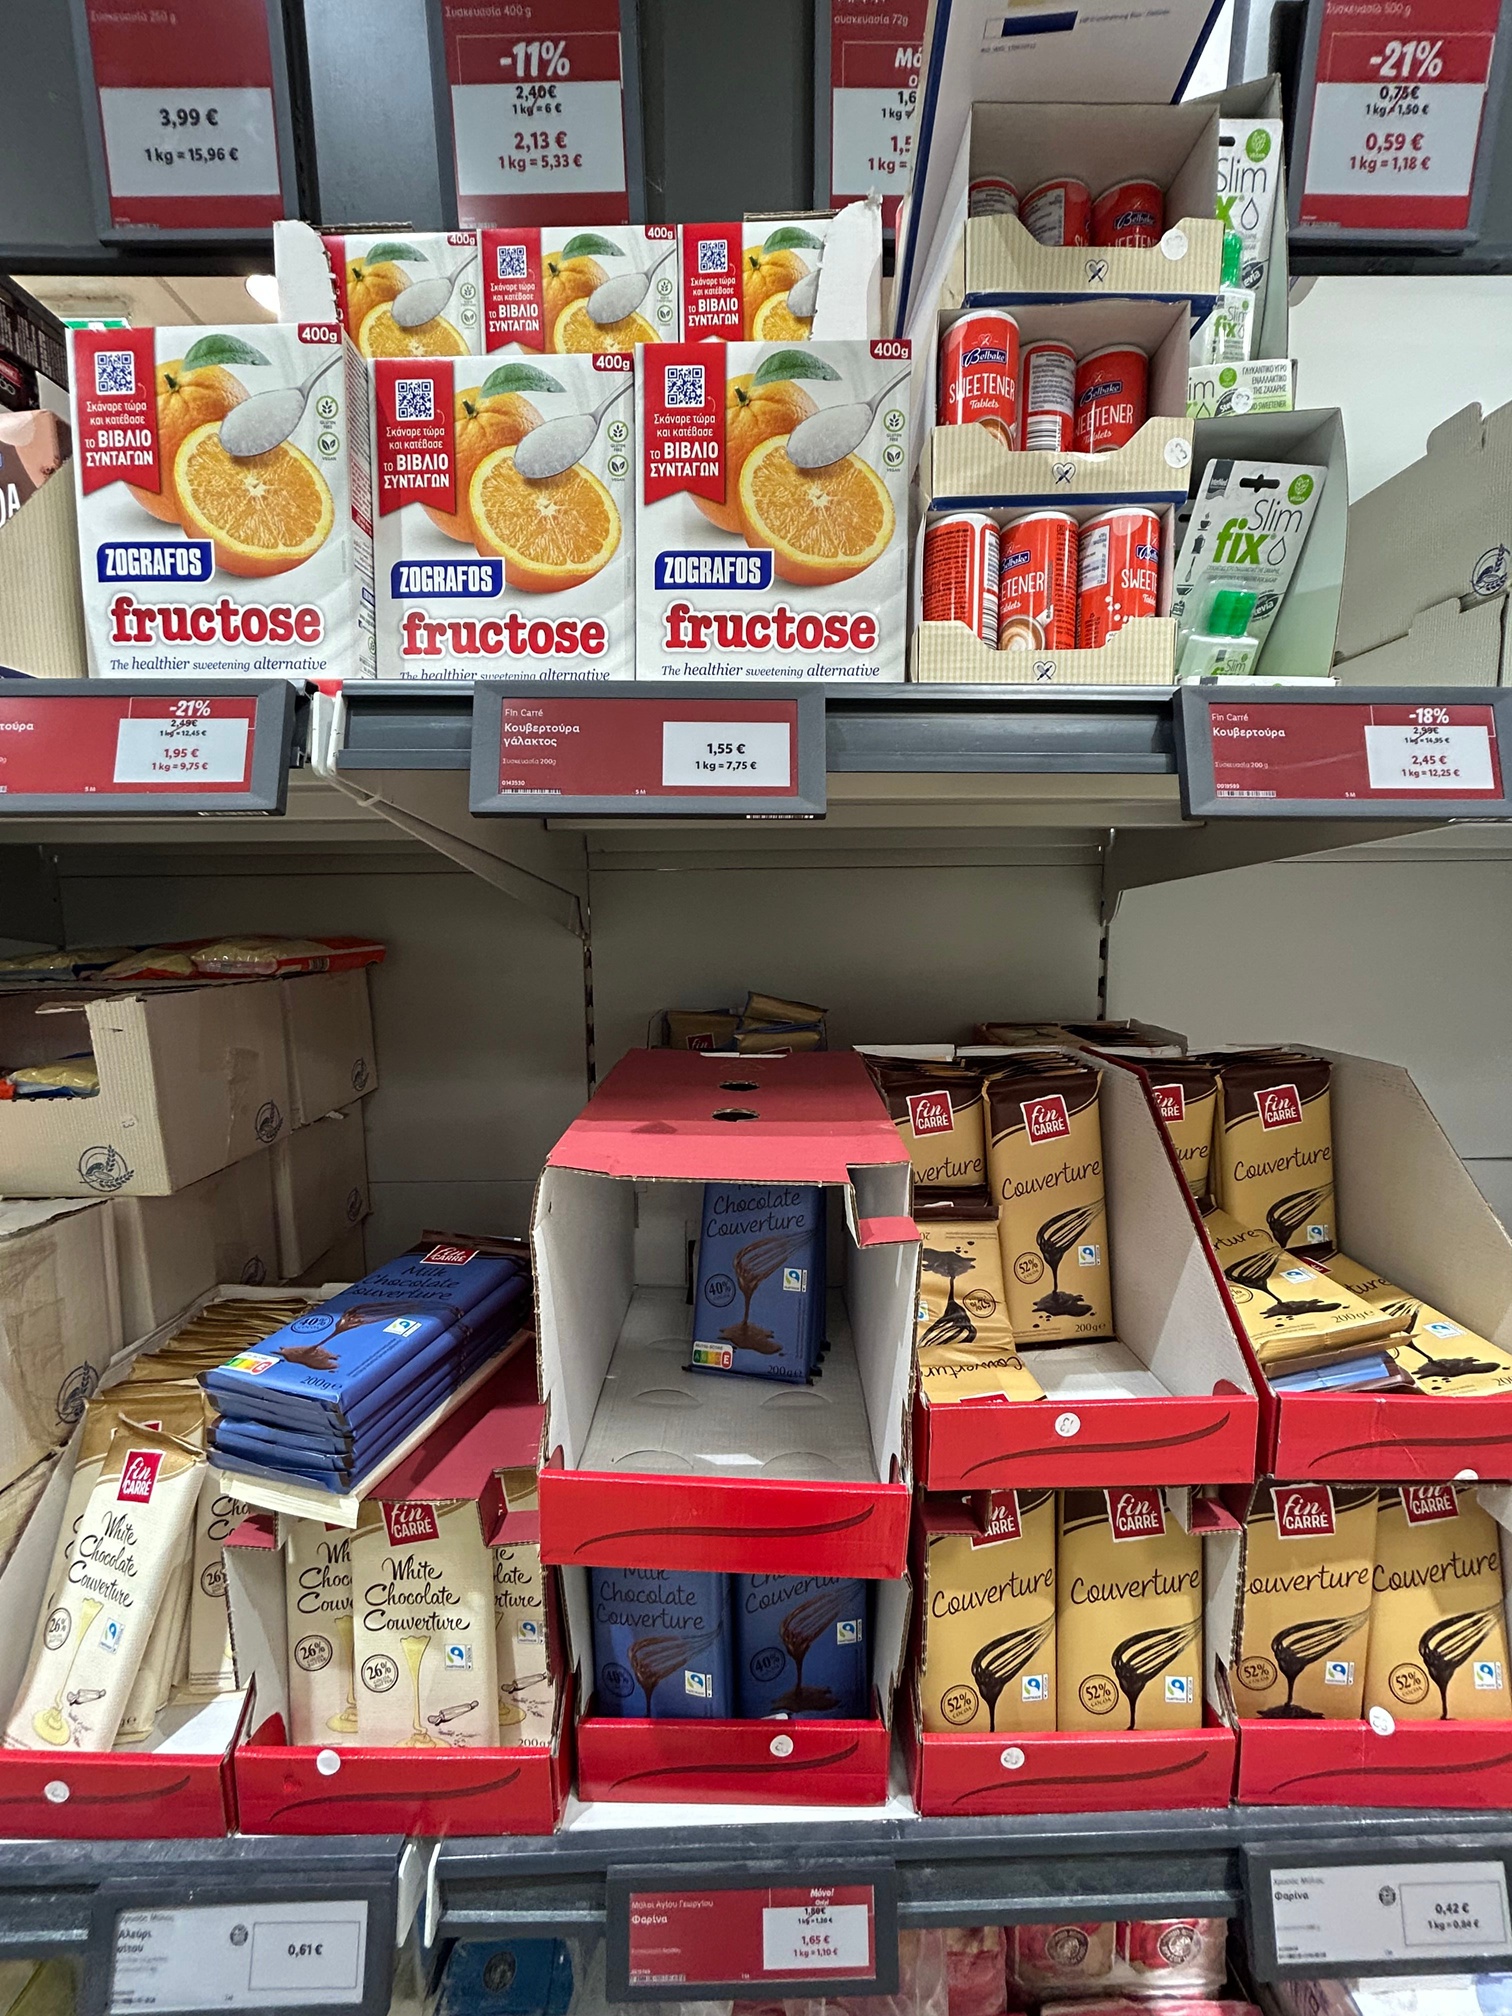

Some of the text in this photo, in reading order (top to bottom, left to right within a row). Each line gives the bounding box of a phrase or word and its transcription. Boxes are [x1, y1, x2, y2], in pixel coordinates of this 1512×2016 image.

[503, 6, 523, 17] 400
[525, 8, 532, 19] g
[834, 14, 909, 27] συσκευασία 72g
[499, 40, 571, 78] -11%
[1369, 39, 1445, 78] -21%
[159, 107, 219, 129] 3,99 €
[513, 131, 568, 153] 2,13 €
[1365, 132, 1425, 154] 0,59 €
[144, 147, 239, 165] 1 kg = 15,96 €
[498, 153, 583, 172] 1 kg = 5,33 €
[1349, 155, 1431, 174] 1 kg = 1,18 €
[448, 233, 477, 246] 400g
[646, 226, 675, 240] 400g
[498, 303, 539, 318] ΒΙΒΛΙΟ
[301, 326, 339, 344] 400g
[488, 318, 540, 333] ΣΥΝΤΑΓΩΝ
[873, 342, 910, 359] 400g
[964, 348, 1007, 368] Belbake
[595, 354, 631, 371] 400g
[949, 372, 1016, 404] SWEETENER
[969, 399, 1000, 410] Tablets
[654, 412, 716, 427] Σκάναρε τώρα
[84, 429, 152, 449] το ΒΙΒΛΙΟ
[656, 425, 714, 438] και κατέβασε
[85, 449, 154, 468] ΣΥΝΤΑΓΩΝ
[650, 440, 719, 460] το ΒΙΒΛΙΟ
[383, 453, 449, 472] το ΒΙΒΛΙΟ
[650, 460, 719, 478] ΣΥΝΤΑΓΩΝ
[383, 472, 450, 489] ΣΥΝΤΑΓΩΝ
[1247, 498, 1303, 533] Slim
[103, 548, 203, 577] ZOGRAFOS
[663, 556, 762, 584] ZOGRAFOS
[399, 565, 493, 593] ZOGRAFOS
[110, 595, 323, 643] fructose
[665, 602, 877, 650] fructose
[402, 611, 606, 656] fructose
[110, 656, 327, 674] The healthier sweetening alternative
[661, 662, 880, 679] The healthier sweetening alternative
[168, 700, 211, 717] -21%
[504, 707, 543, 717] Fin Carré
[1211, 712, 1249, 722] Fin Carré
[1408, 707, 1450, 725] -18%
[504, 721, 580, 735] Κουβερτούρα
[1213, 726, 1286, 738] Κουβερτούρα
[503, 735, 557, 748] γάλακτος
[706, 743, 746, 756] 1,55 €
[163, 748, 199, 760] 1,95 €
[1411, 754, 1447, 766] 2,45 €
[702, 761, 716, 772] kg
[726, 761, 748, 772] 7,75
[750, 761, 757, 770] €
[1408, 768, 1420, 779] kg
[1429, 769, 1451, 779] 12,25
[1453, 769, 1460, 777] €
[1265, 1094, 1292, 1120] fin
[1266, 1103, 1298, 1123] CARRÉ
[1031, 1104, 1060, 1132] fin
[1033, 1115, 1067, 1137] CARRÉ
[1233, 1146, 1332, 1183] Couverture
[1001, 1157, 1101, 1201] Couverture
[712, 1188, 801, 1216] Chocolate
[705, 1211, 806, 1239] Couverture
[401, 1265, 448, 1279] Milk
[1018, 1256, 1040, 1275] 52%
[362, 1273, 460, 1290] Chocolate
[347, 1284, 453, 1302] Couverture
[126, 1456, 152, 1485] fin
[122, 1477, 153, 1496] CARRÉ
[1116, 1493, 1152, 1528] fin
[1282, 1492, 1322, 1527] fin
[1411, 1494, 1453, 1515] CARRÉ
[101, 1509, 139, 1547] White
[393, 1516, 434, 1538] CARRÉ
[1119, 1511, 1160, 1532] CARRÉ
[1285, 1511, 1329, 1530] CARRÉ
[79, 1533, 139, 1578] Chocolate
[381, 1553, 444, 1580] White
[1371, 1550, 1500, 1593] Couverture
[67, 1559, 134, 1609] Couverture
[600, 1581, 697, 1606] Chocolate
[932, 1567, 1055, 1619] Couverture
[1070, 1567, 1200, 1605] Couverture
[363, 1582, 462, 1607] Chocolate
[362, 1608, 471, 1632] Couverture
[596, 1603, 705, 1631] Couverture
[366, 1659, 393, 1680] 26%
[1243, 1663, 1270, 1678] 52%
[1395, 1671, 1421, 1690] 52%
[1085, 1683, 1111, 1700] 52%
[946, 1694, 972, 1713] 52%
[1274, 1890, 1309, 1902] Φαρίνα
[631, 1914, 668, 1926] Φαρίνα
[801, 1934, 830, 1946] 1,65 €
